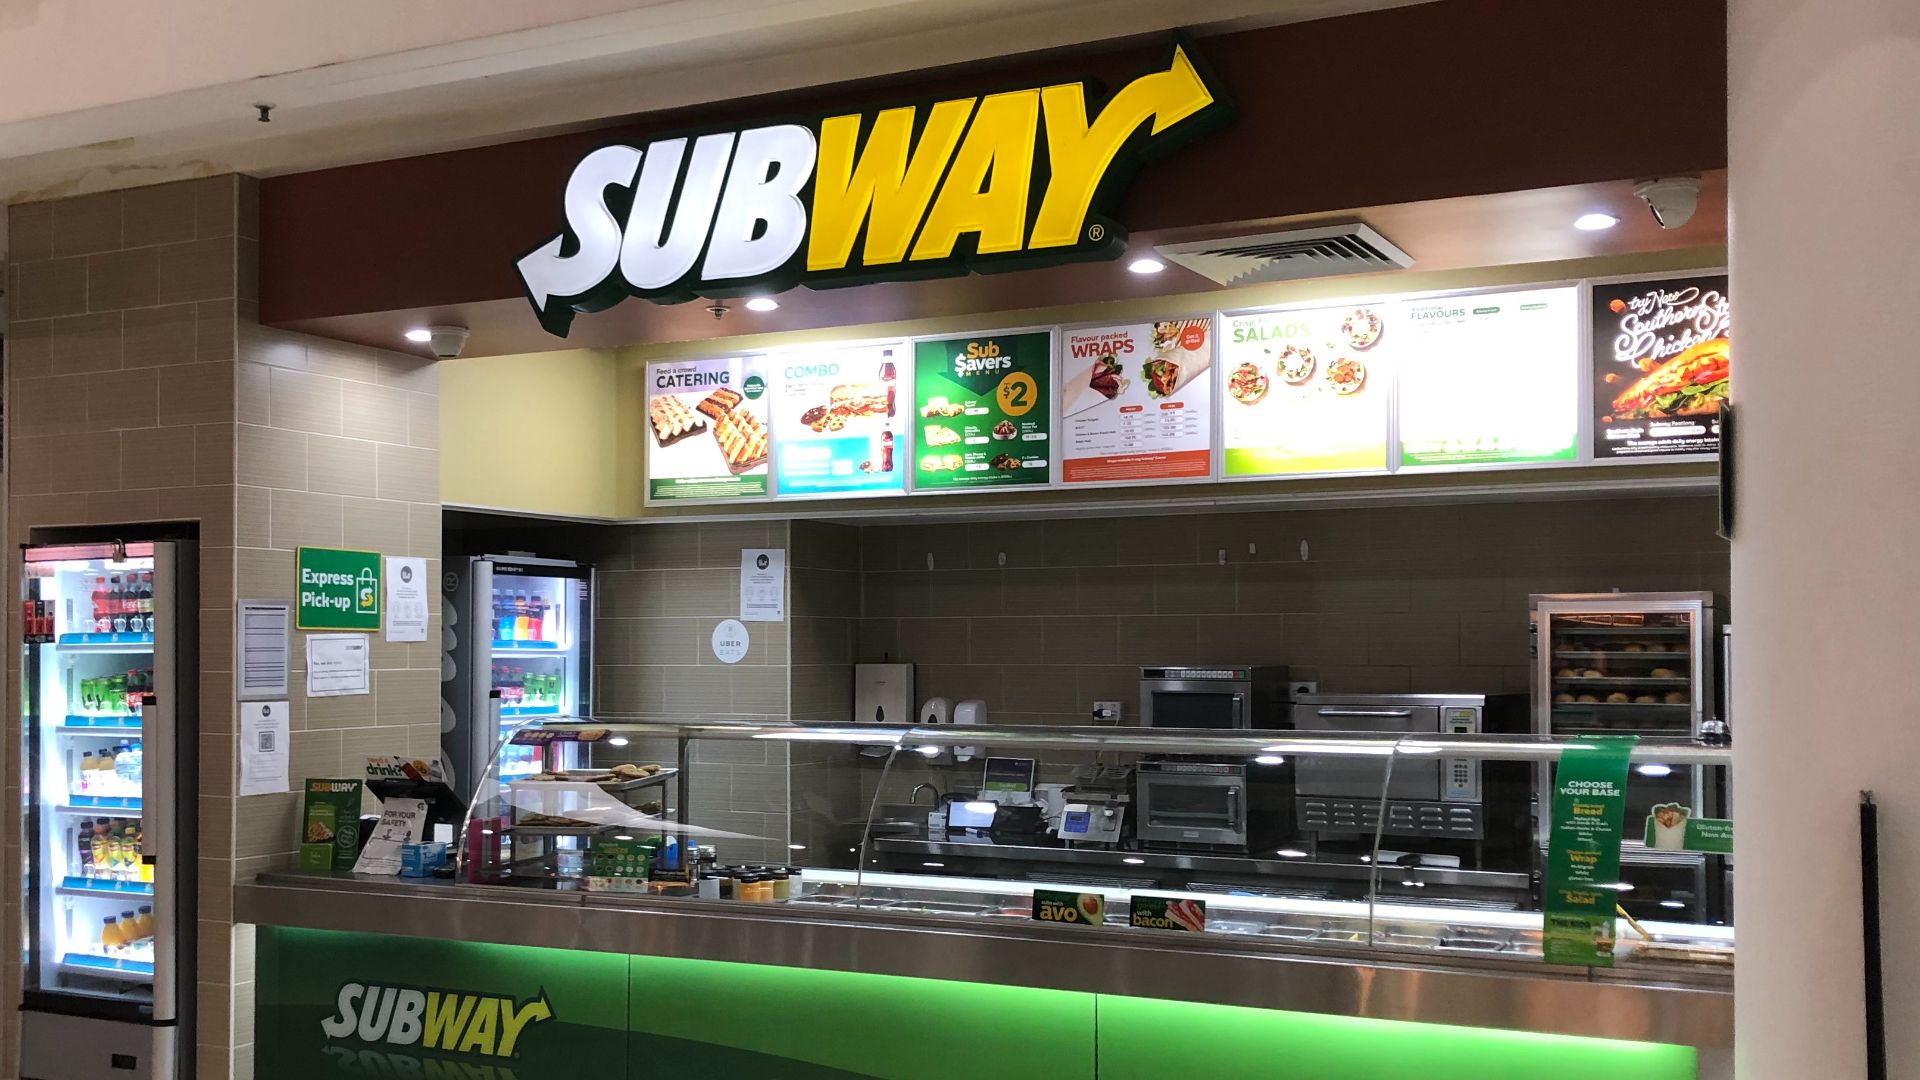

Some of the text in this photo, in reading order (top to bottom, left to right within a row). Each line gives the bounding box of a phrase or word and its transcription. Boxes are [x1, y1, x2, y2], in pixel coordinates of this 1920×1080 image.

[517, 44, 1214, 311] SUBWAY
[1627, 287, 1700, 316] try New
[1411, 308, 1466, 320] FLAVOURS
[1071, 331, 1128, 344] Flavour packed
[1233, 322, 1311, 344] SALADS
[1614, 303, 1702, 362] Southern
[967, 341, 1000, 359] Sub
[1071, 338, 1135, 359] WRAPS
[784, 363, 840, 379] COMBO
[966, 369, 1000, 377] MENU
[656, 371, 730, 388] CATERING
[302, 568, 354, 588] Express
[302, 592, 351, 612] Pick-up
[366, 763, 402, 777] drink?
[310, 782, 358, 793] SUBWAY
[1560, 787, 1620, 797] YOUR BASE
[1568, 781, 1614, 789] CHOOSE
[384, 810, 416, 819] FOR YOUR
[1573, 806, 1603, 816] Bread
[380, 819, 407, 827] SAFETY
[1570, 854, 1598, 865] Wrap
[1039, 905, 1078, 922] avo
[1132, 911, 1174, 928] bacon
[320, 981, 552, 1058] SUBWAY
